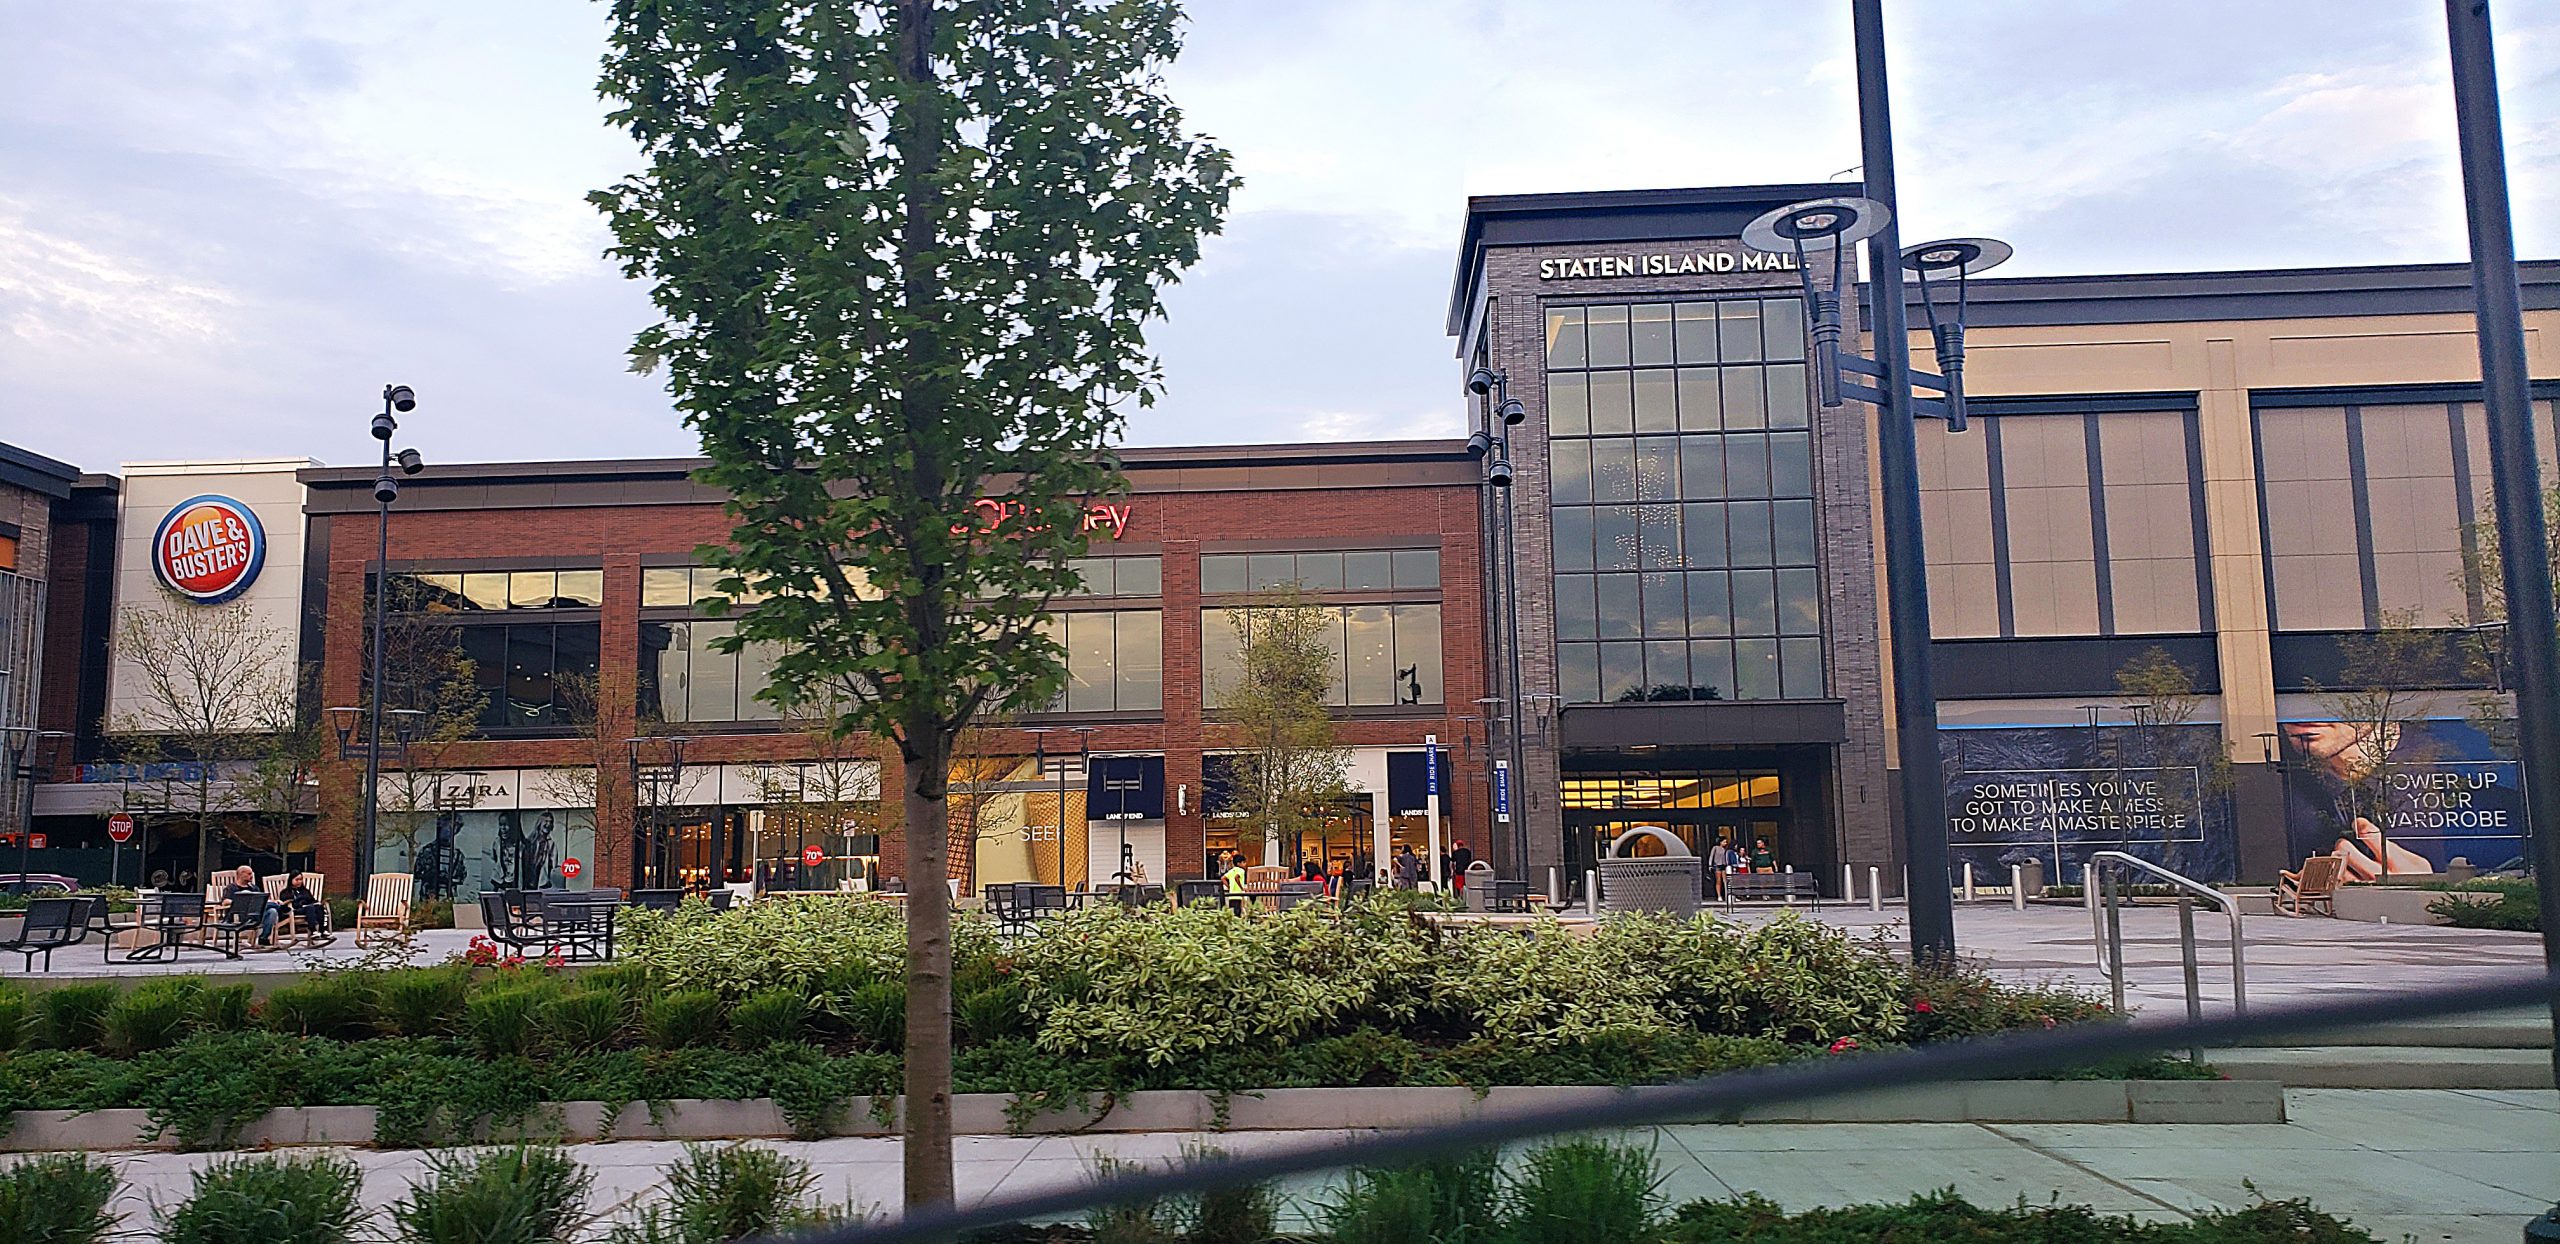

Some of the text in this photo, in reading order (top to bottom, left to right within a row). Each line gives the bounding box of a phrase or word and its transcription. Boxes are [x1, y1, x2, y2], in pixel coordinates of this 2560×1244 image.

[1540, 256, 1635, 279] STATEN
[1642, 253, 1735, 276] ISLAND
[170, 517, 245, 559] DAVE &
[171, 540, 247, 580] BUSTER'S
[2087, 779, 2157, 797] YOU'VE
[2467, 772, 2498, 790] UP
[447, 785, 510, 797] ZARA
[1966, 800, 2004, 816] GOT
[2010, 800, 2035, 815] TO
[2041, 799, 2093, 815] MAKE
[2100, 799, 2112, 813] A
[2407, 792, 2473, 809] YOUR
[110, 821, 131, 833] STOP
[1950, 814, 2186, 833] TO MAKE A MASTERPIECE
[2377, 810, 2508, 829] WARDROBE
